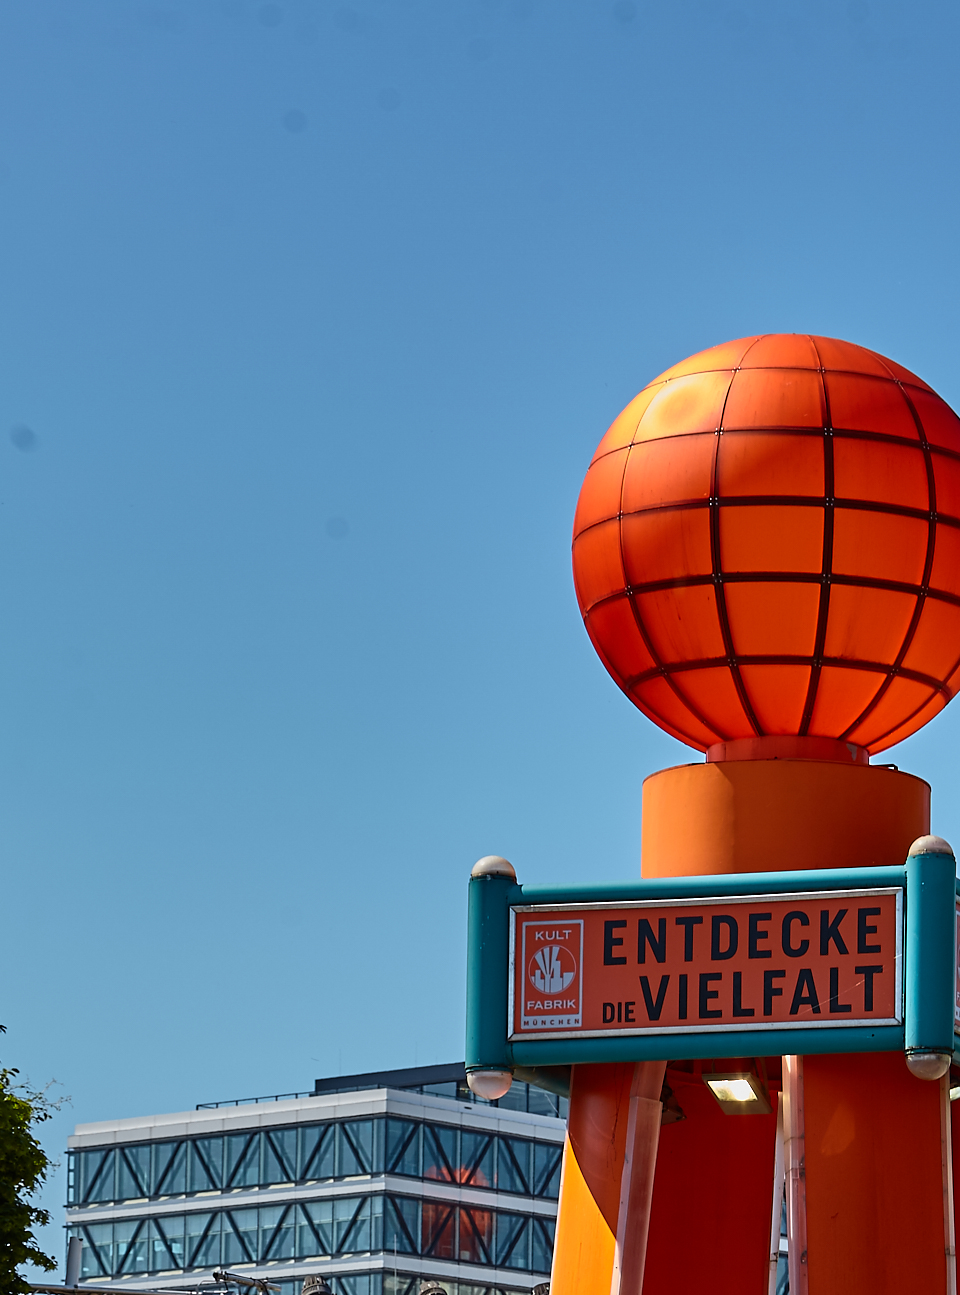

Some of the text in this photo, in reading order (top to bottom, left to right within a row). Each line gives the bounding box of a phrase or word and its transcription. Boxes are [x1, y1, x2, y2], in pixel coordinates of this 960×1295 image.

[535, 929, 572, 941] KULT
[603, 907, 881, 966] ENTDECKE
[602, 965, 884, 1024] DIE VIELFALT
[527, 998, 576, 1011] FABRIK
[523, 1017, 581, 1027] MÜNCHEN
